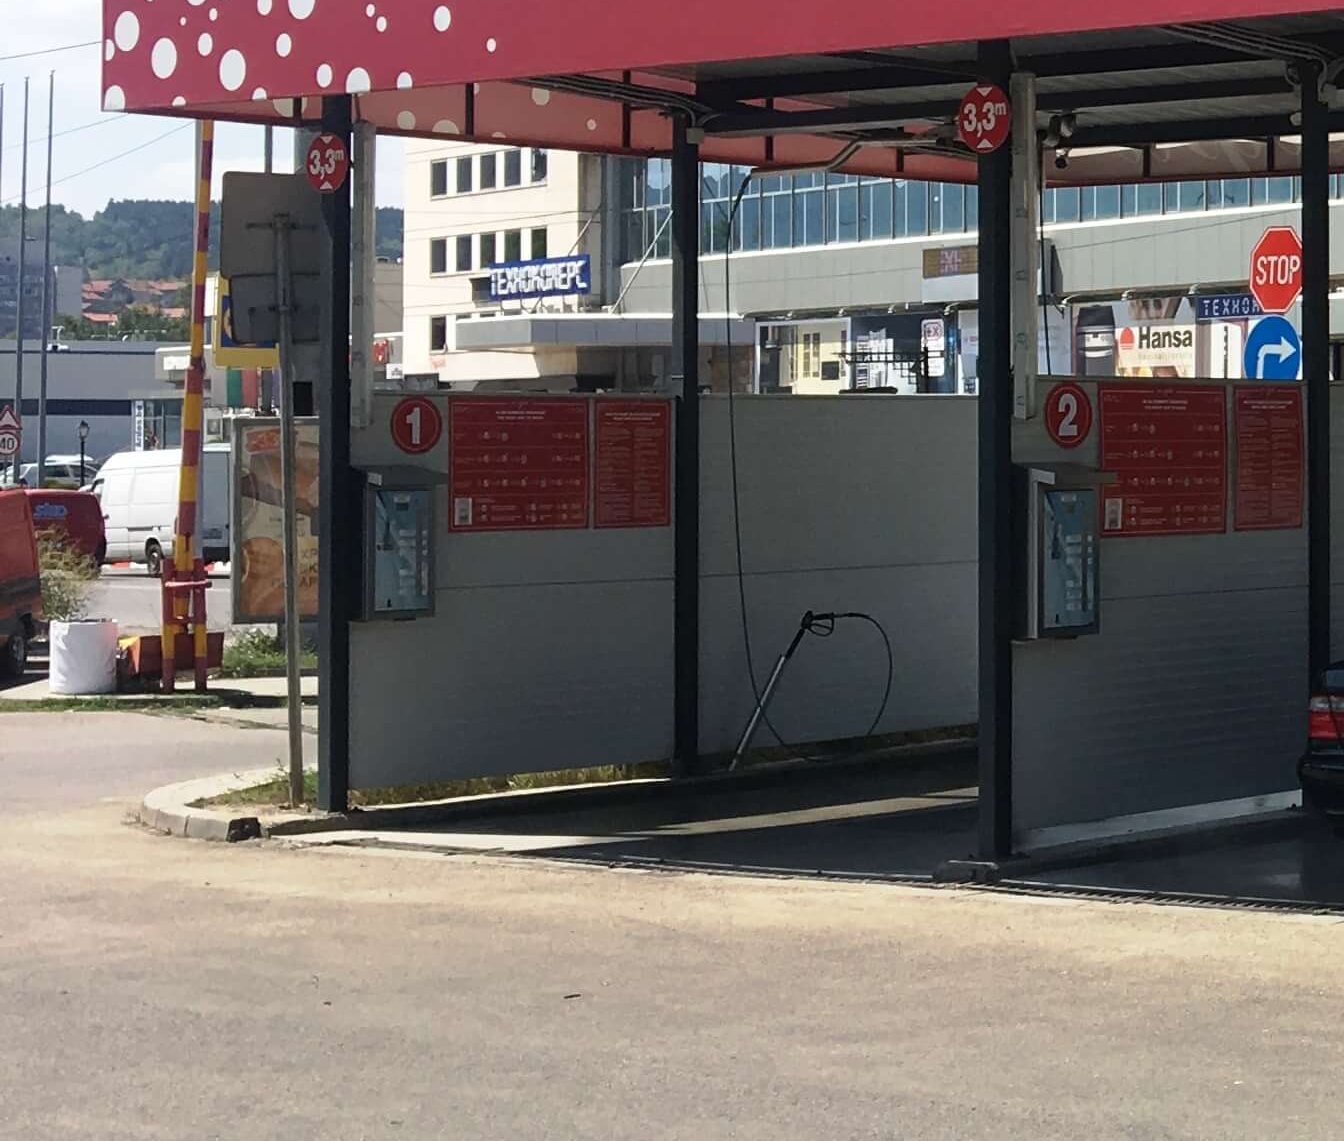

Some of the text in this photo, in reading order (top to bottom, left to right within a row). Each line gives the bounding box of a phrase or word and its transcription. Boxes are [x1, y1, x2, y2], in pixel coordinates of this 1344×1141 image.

[1255, 255, 1301, 285] STOP
[1138, 325, 1193, 349] Hansa
[405, 407, 421, 445] 1
[1058, 393, 1078, 436] 2
